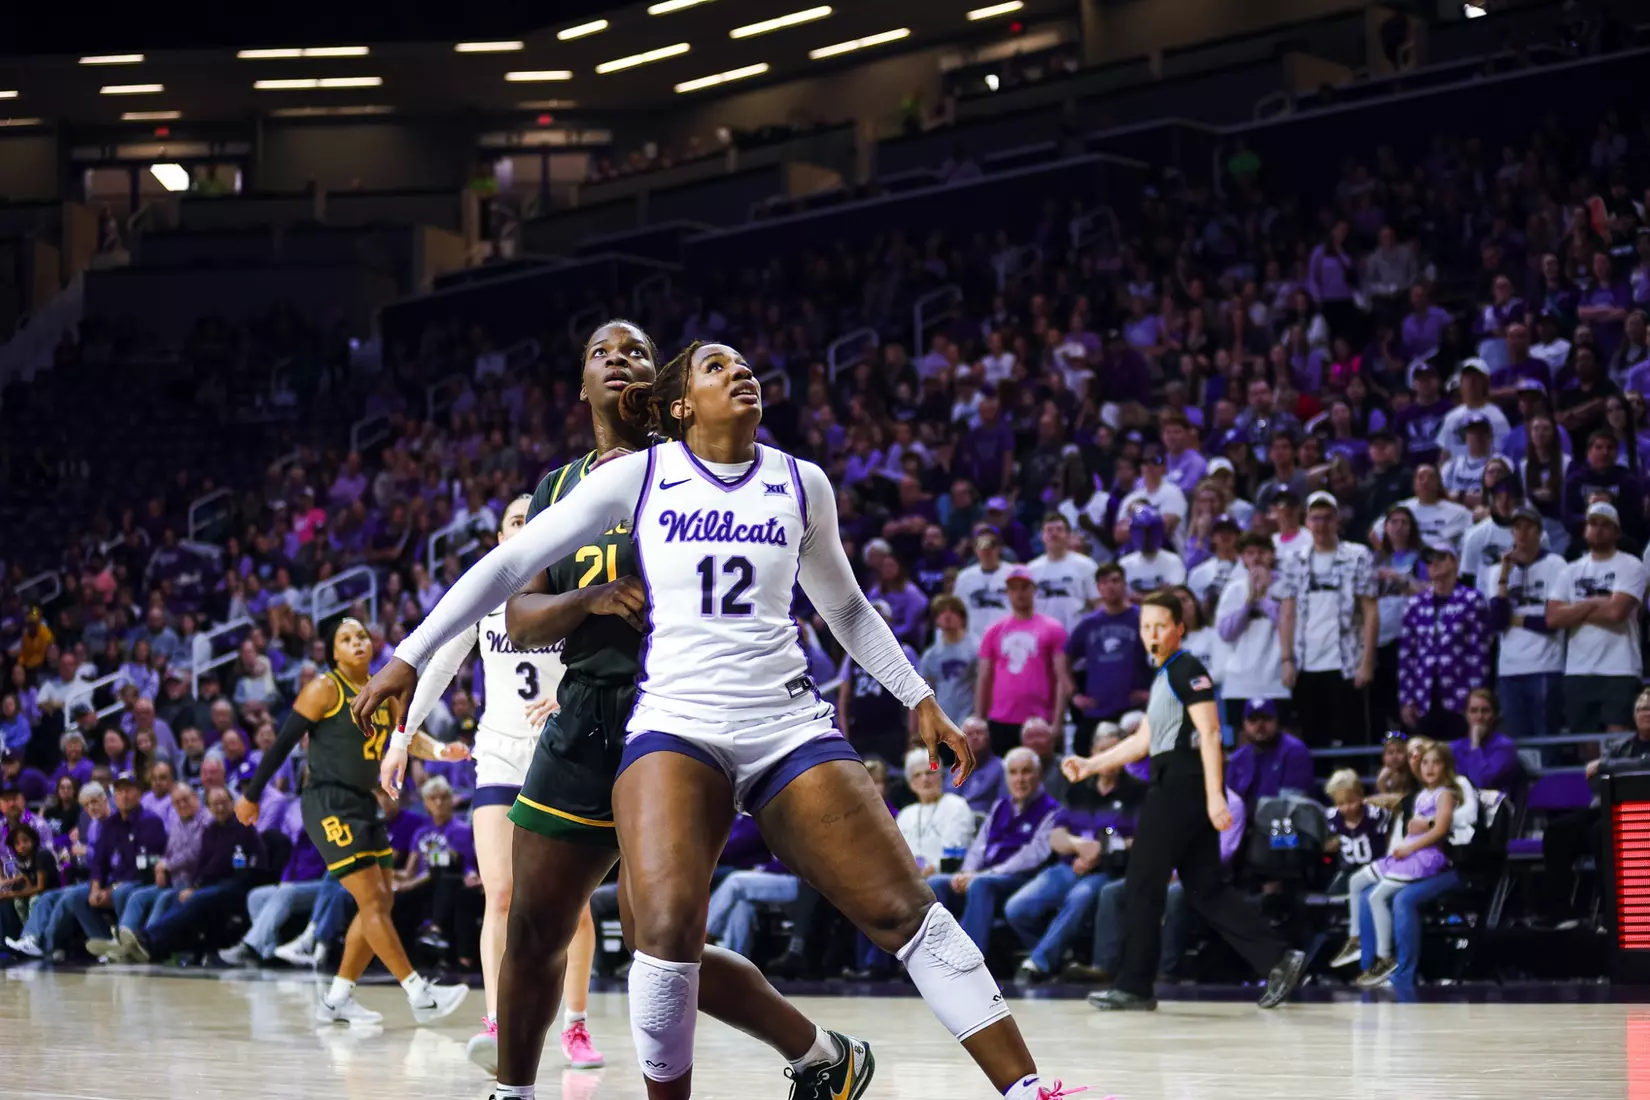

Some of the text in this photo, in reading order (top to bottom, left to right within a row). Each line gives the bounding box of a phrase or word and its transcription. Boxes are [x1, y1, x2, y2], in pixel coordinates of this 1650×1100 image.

[659, 509, 787, 547] Wildcats
[575, 544, 617, 589] 21
[696, 555, 756, 618] 12
[515, 661, 539, 700] 3
[320, 815, 354, 848] BU
